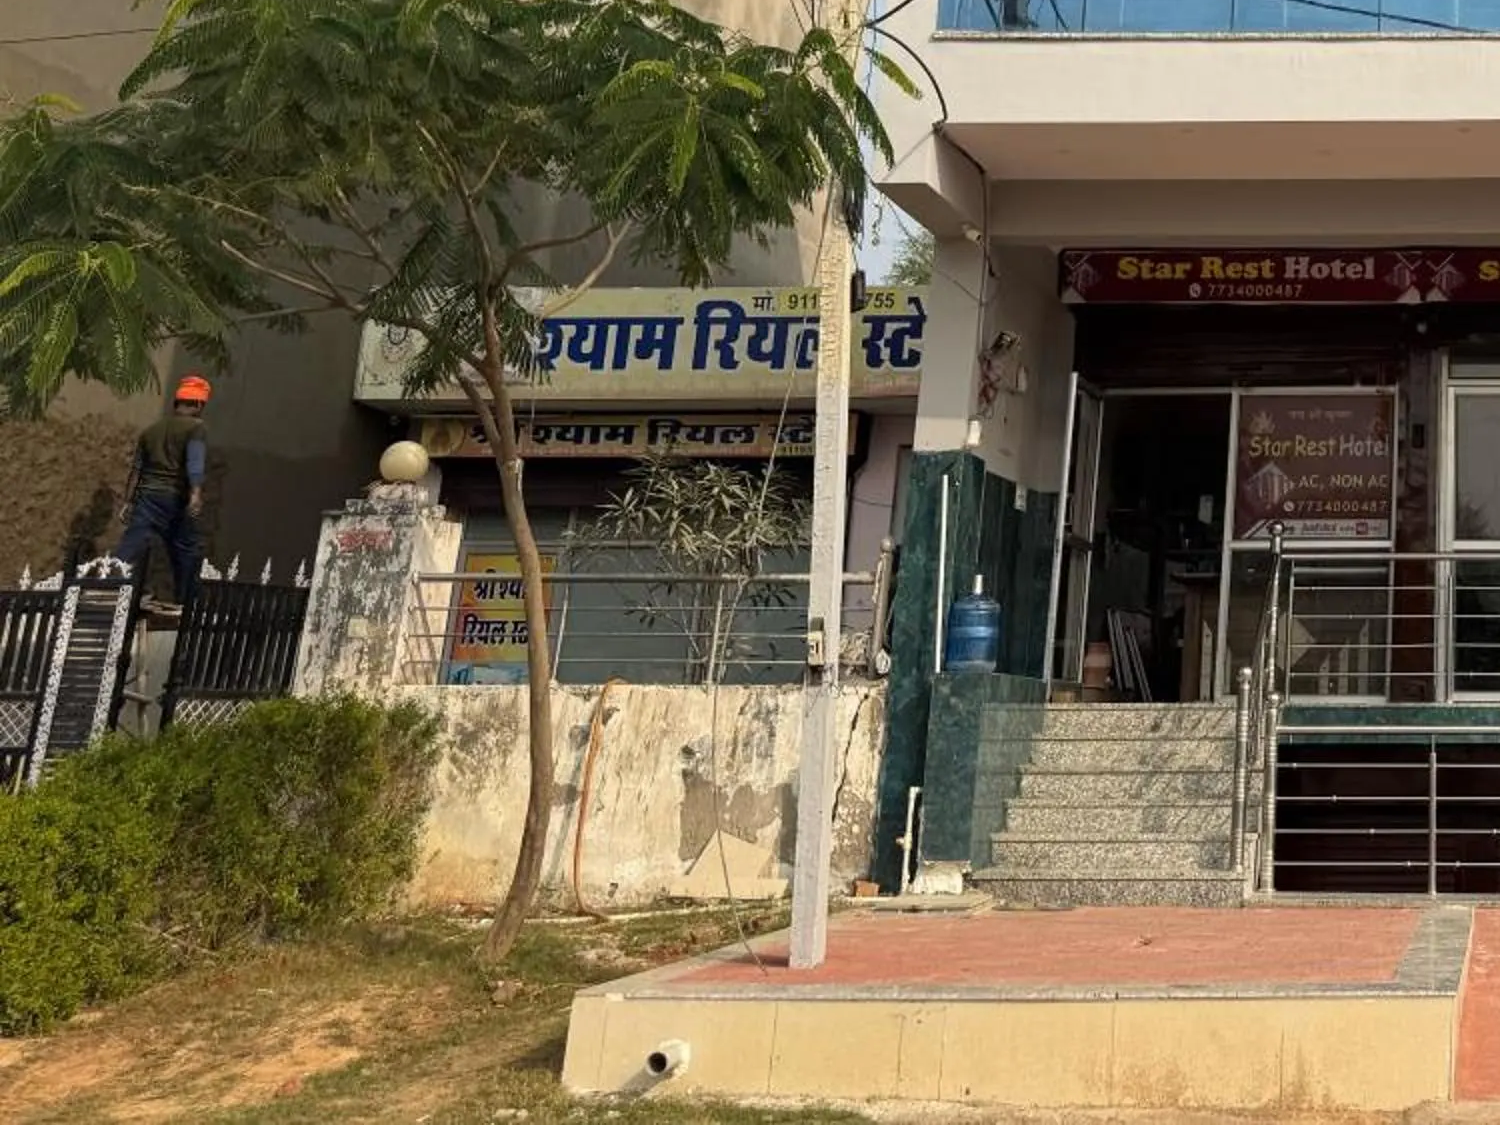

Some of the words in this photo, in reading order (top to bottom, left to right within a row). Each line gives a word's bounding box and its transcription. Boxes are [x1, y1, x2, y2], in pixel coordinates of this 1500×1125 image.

[1116, 256, 1192, 280] Star
[1200, 256, 1276, 280] Rest
[1284, 255, 1376, 280] Hotel
[1208, 283, 1303, 298] 7734000487
[1249, 435, 1291, 458] Star
[1294, 434, 1336, 457] Rest
[1339, 434, 1389, 457] Hotel
[1330, 474, 1363, 489] NON
[1367, 474, 1389, 488] AC
